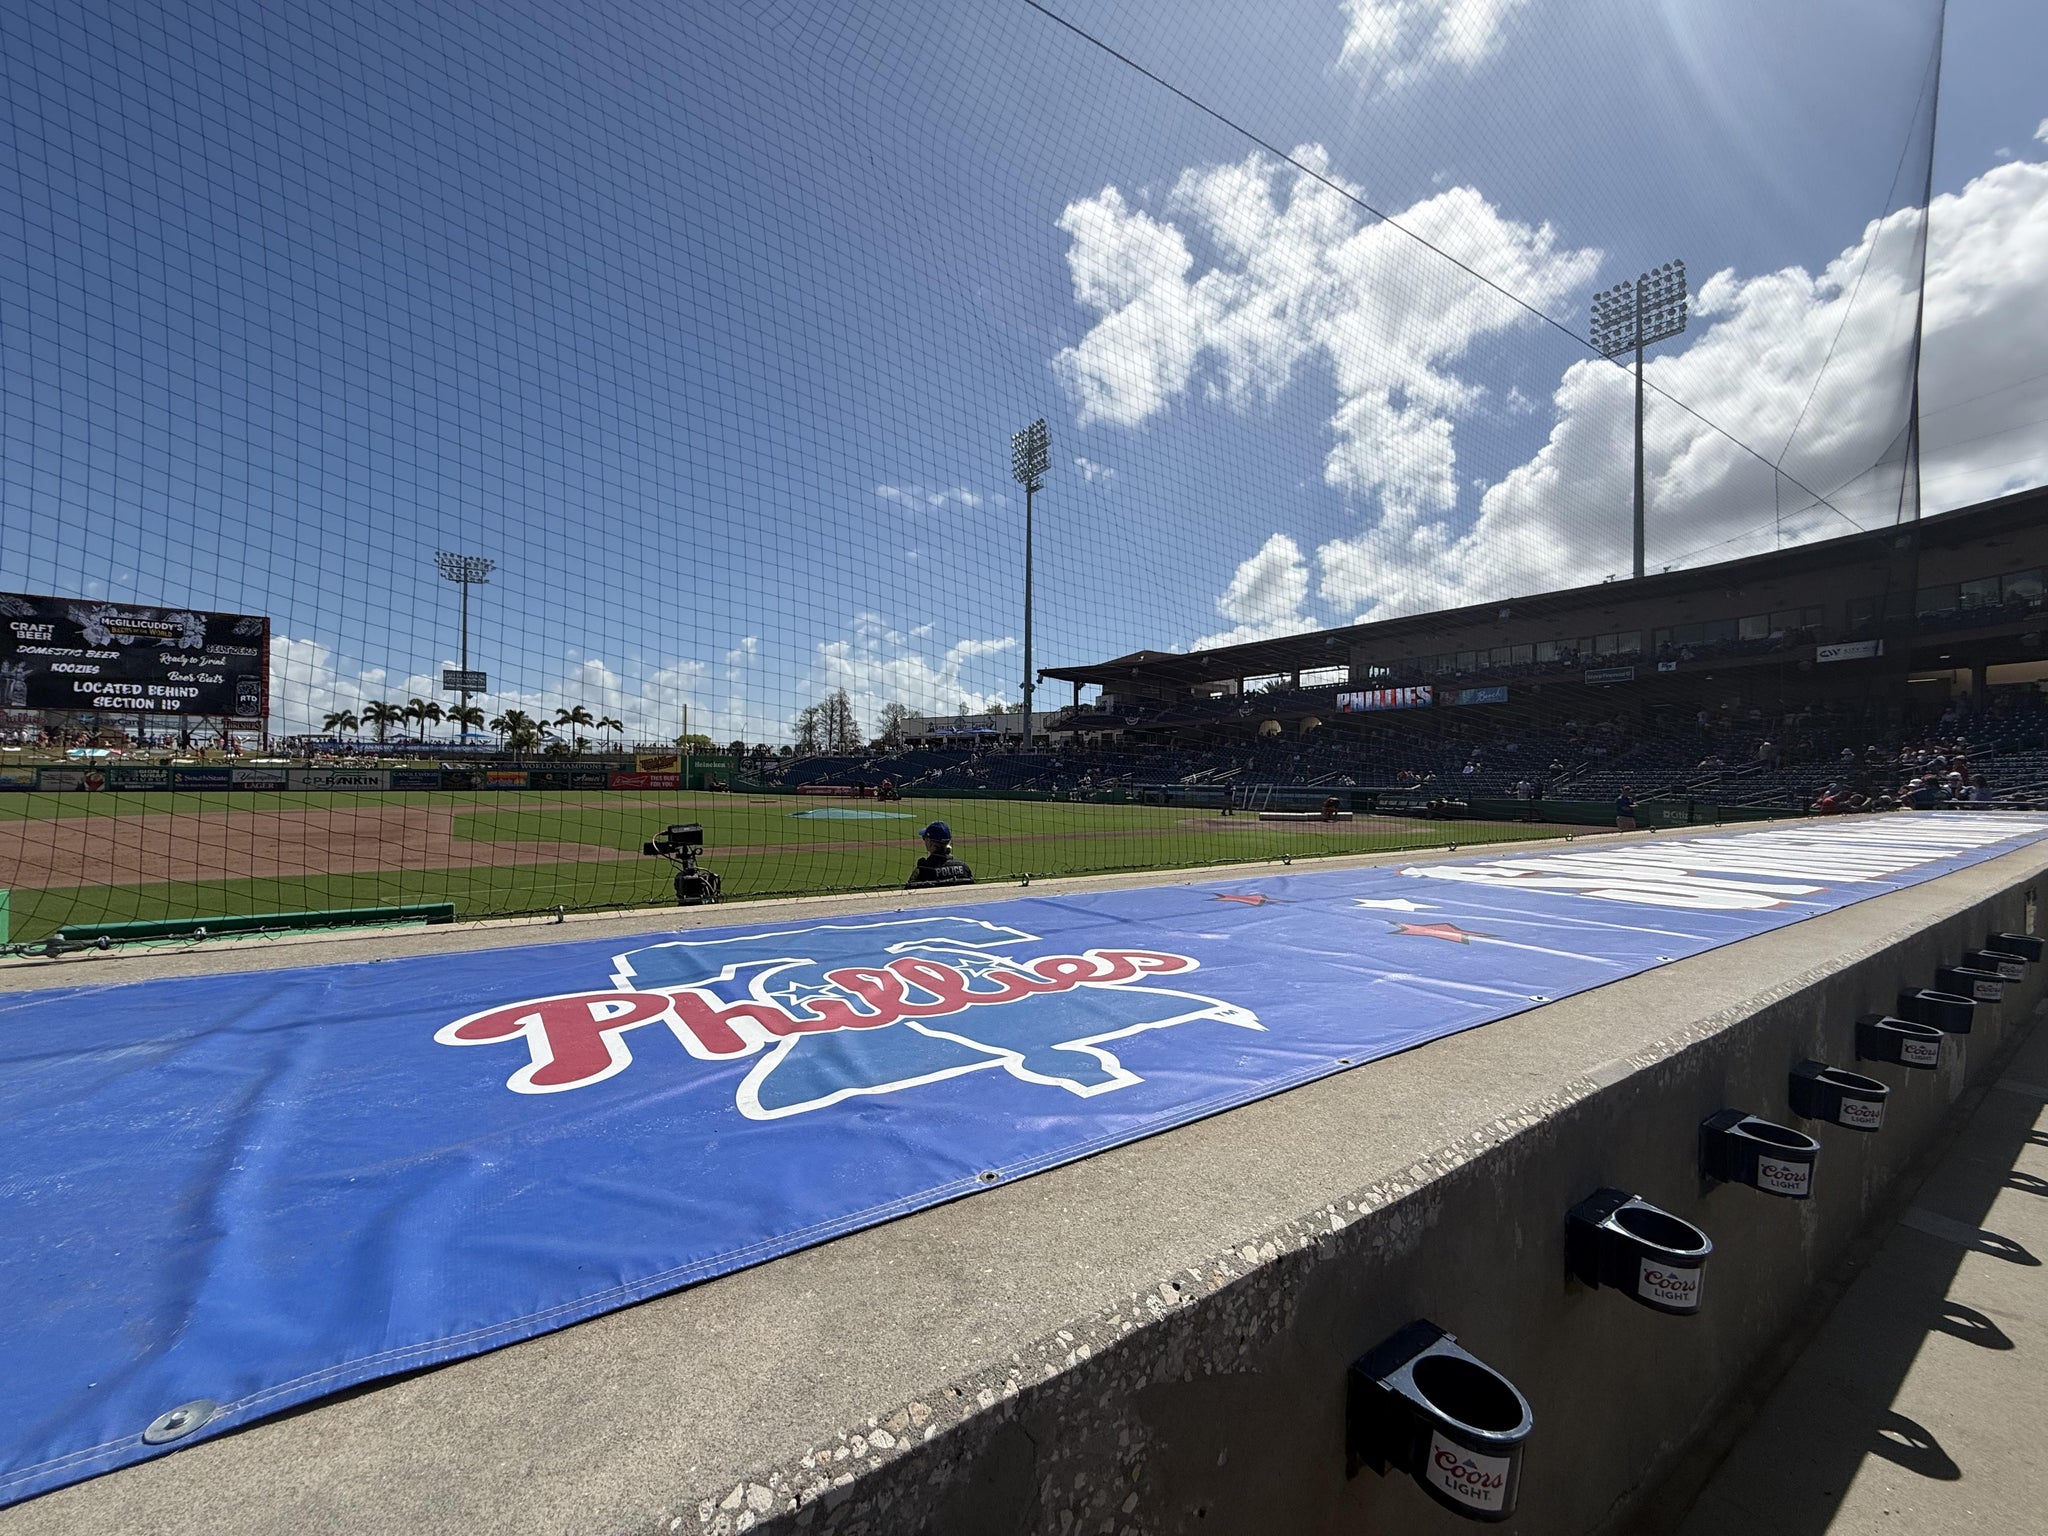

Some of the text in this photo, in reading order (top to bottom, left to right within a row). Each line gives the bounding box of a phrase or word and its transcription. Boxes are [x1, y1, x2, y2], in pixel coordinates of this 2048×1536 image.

[10, 622, 55, 633] CRAFT
[101, 617, 183, 631] McGILLICUDDY'S
[16, 631, 52, 640] BEER
[16, 645, 120, 659] DOMESTIC BEER
[206, 644, 258, 656] SELTZERS
[159, 652, 227, 667] Ready to Drink
[50, 663, 100, 675] KOOZIES
[167, 670, 196, 682] Beer
[73, 681, 199, 697] LOCATED BEHIND
[93, 696, 181, 710] SECTION 119
[240, 694, 257, 702] RTD
[1336, 686, 1433, 713] PHILLIES
[223, 719, 261, 729] THRESHERS
[1671, 811, 1703, 820] Citizns
[935, 866, 964, 876] POLICE
[434, 947, 1201, 1094] Phillies
[1905, 1044, 1936, 1056] Coors
[1844, 1104, 1880, 1118] Coors
[1761, 1164, 1806, 1182] Coors
[1770, 1179, 1800, 1189] LIGHT
[1643, 1268, 1697, 1292] Coors
[1654, 1288, 1689, 1301] LIGHT
[1434, 1444, 1503, 1489] Coors
[1445, 1475, 1490, 1501] LIGHT
